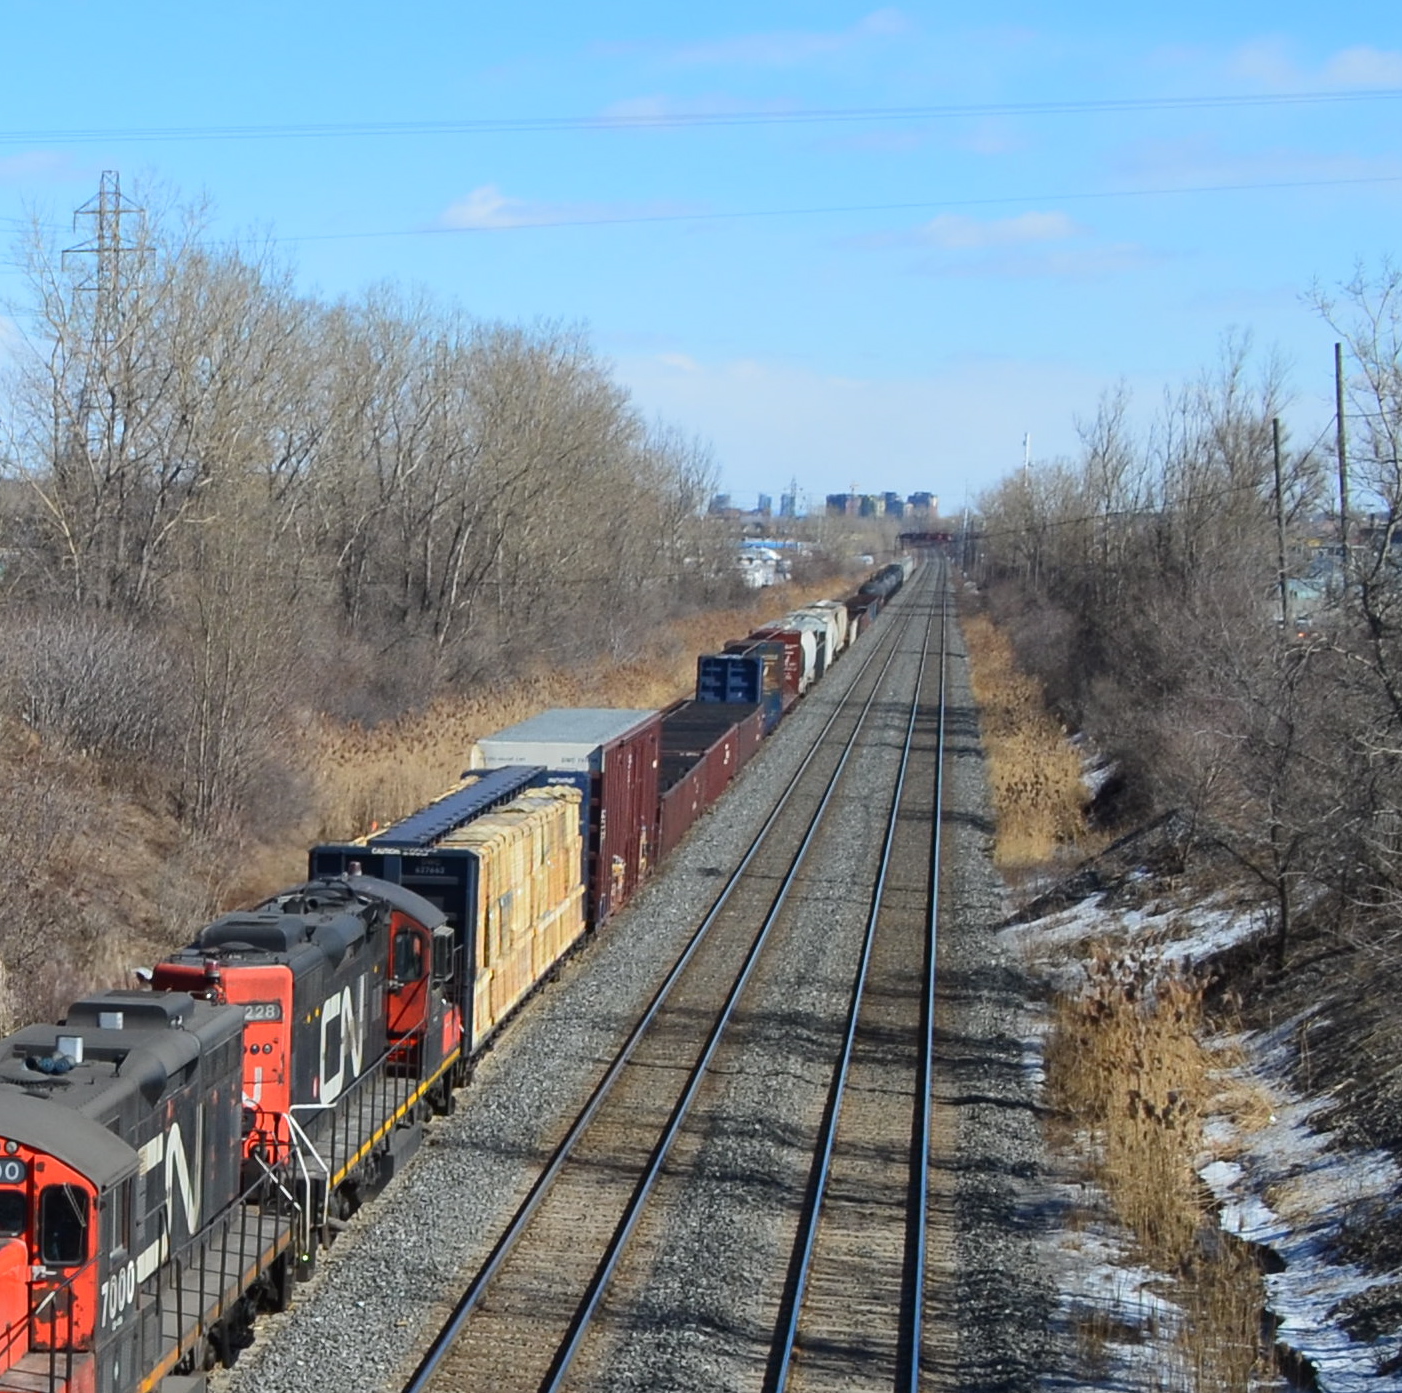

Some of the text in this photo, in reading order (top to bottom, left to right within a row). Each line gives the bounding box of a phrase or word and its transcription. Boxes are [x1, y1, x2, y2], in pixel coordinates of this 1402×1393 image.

[320, 973, 366, 1105] CN
[136, 1103, 204, 1285] CN
[101, 1260, 135, 1329] 7000
